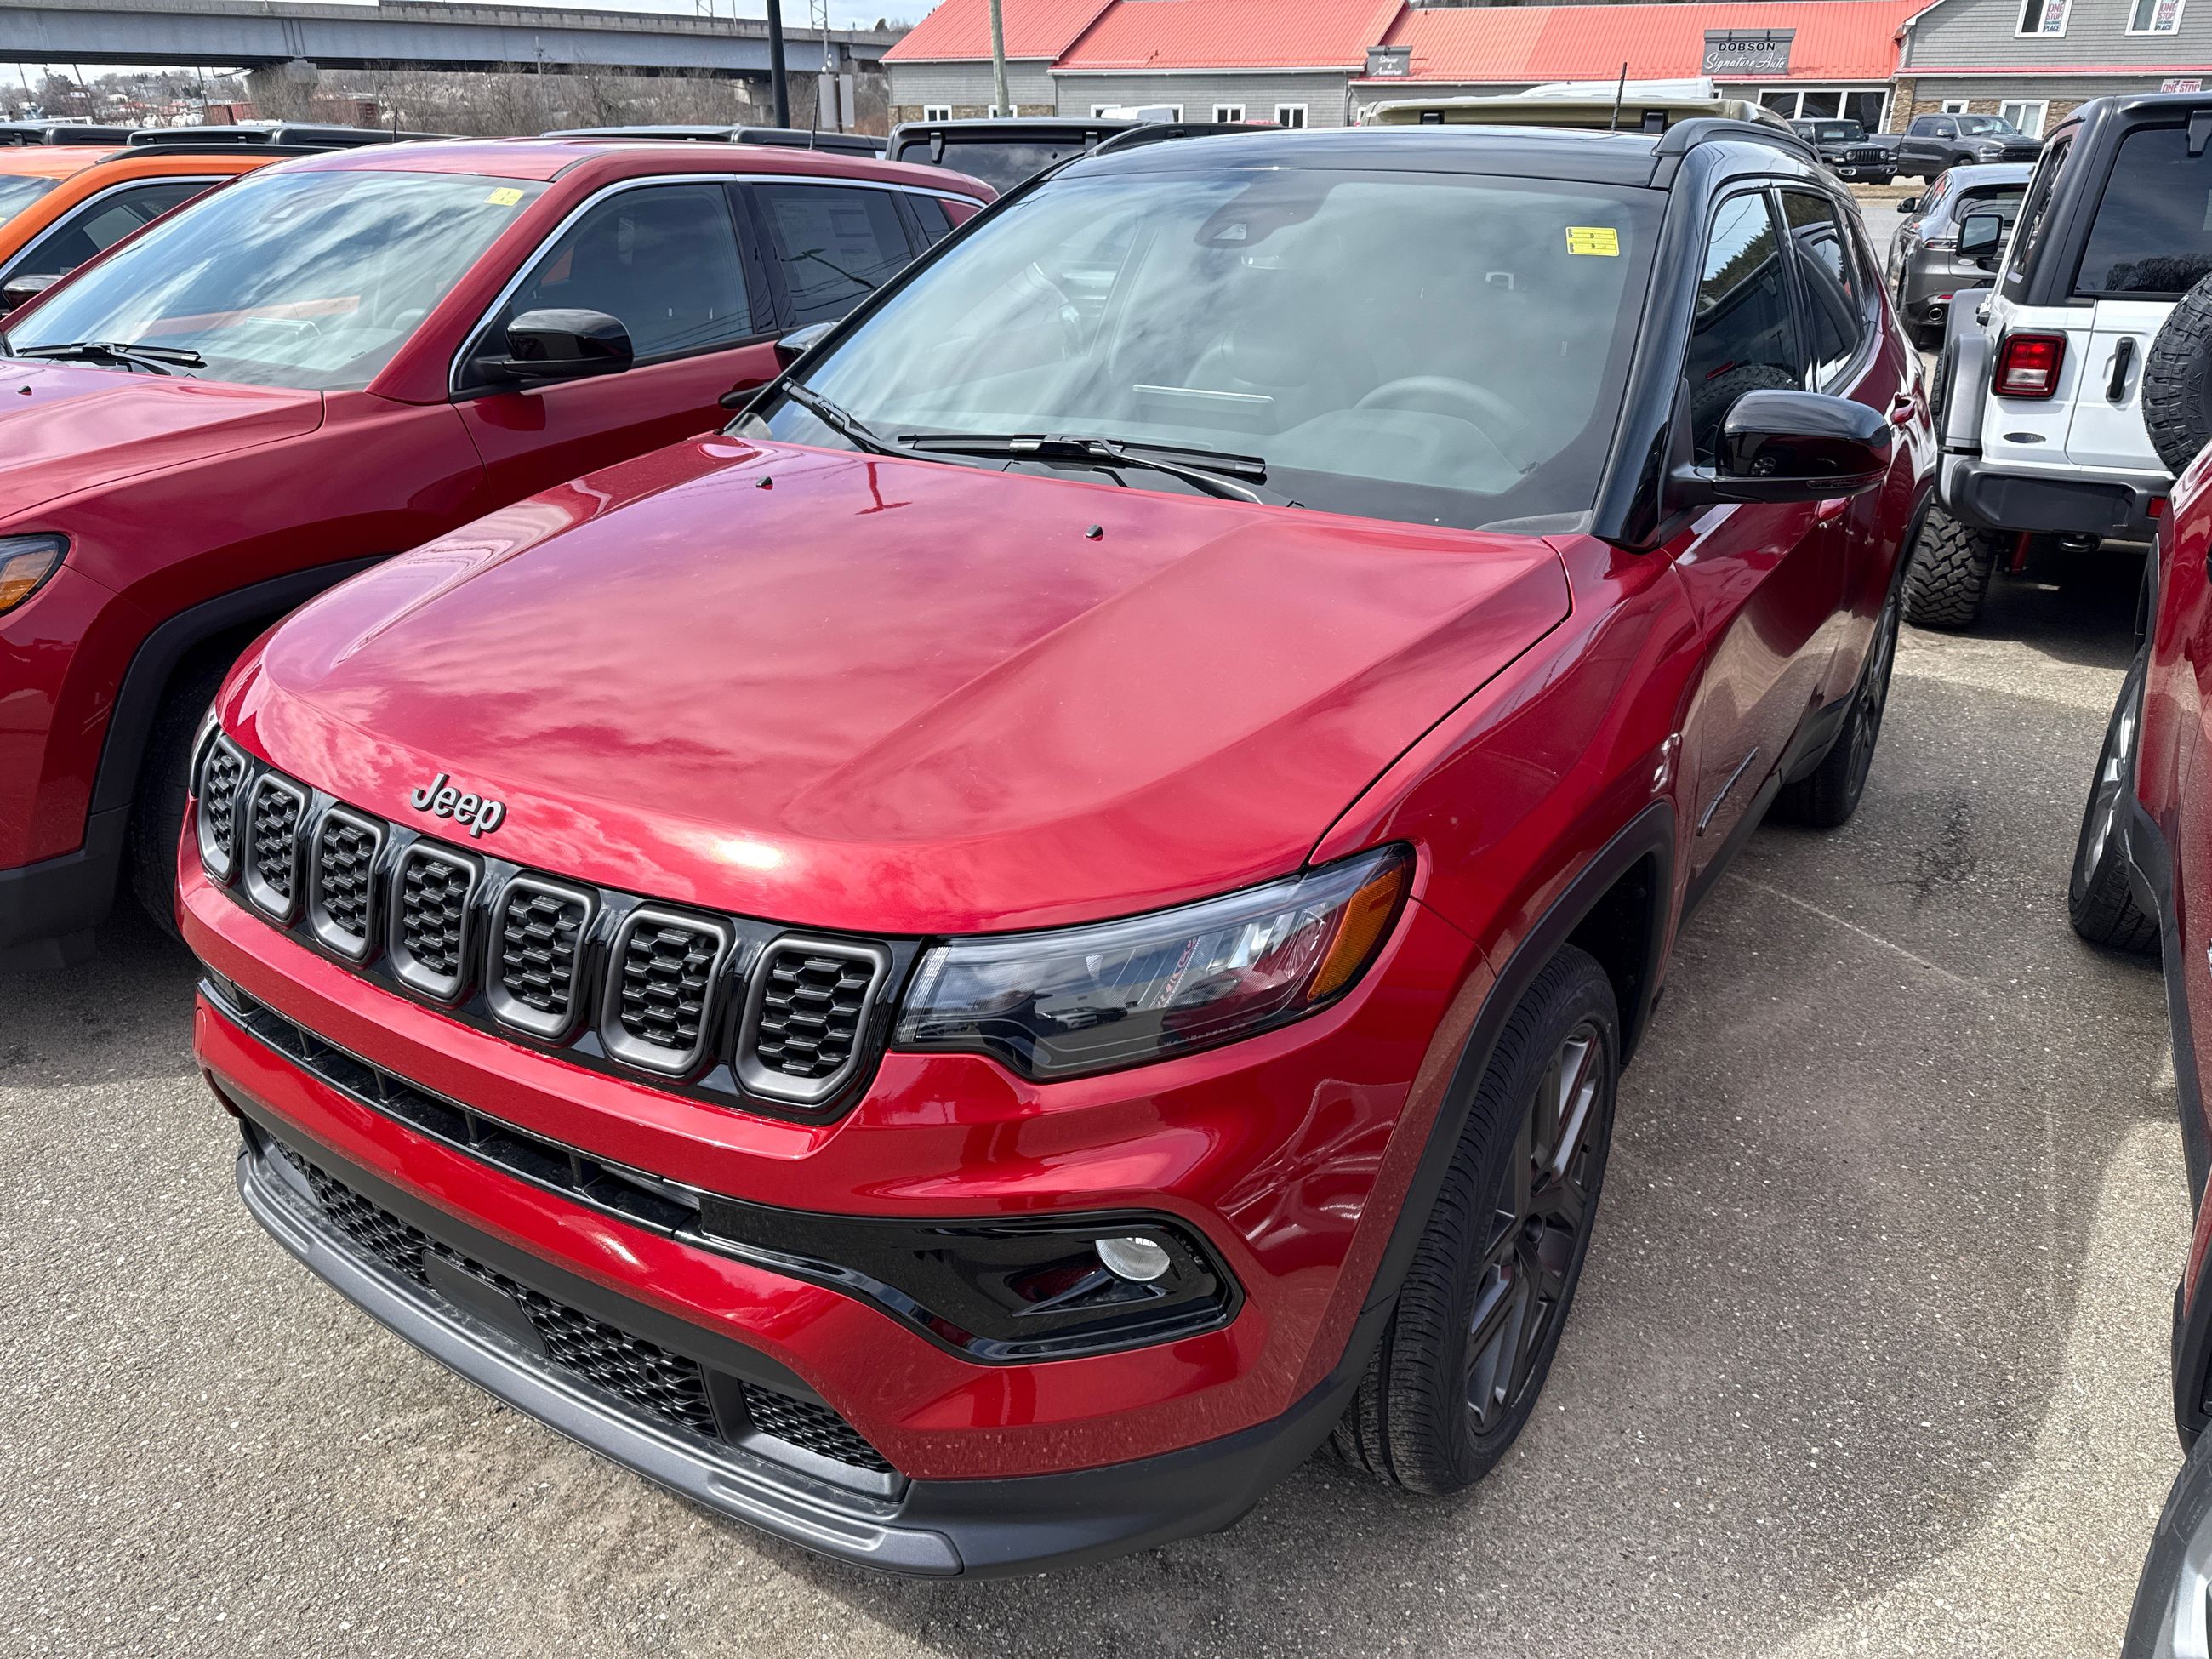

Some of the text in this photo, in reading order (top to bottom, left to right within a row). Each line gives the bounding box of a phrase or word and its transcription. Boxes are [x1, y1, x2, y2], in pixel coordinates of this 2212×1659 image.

[2048, 3, 2064, 12] ONE
[2160, 3, 2177, 12] ONE
[1718, 42, 1776, 53] DOBSON
[1703, 52, 1787, 73] Signature Auto
[2162, 83, 2200, 93] ONE STOP
[411, 772, 507, 839] Jeep
